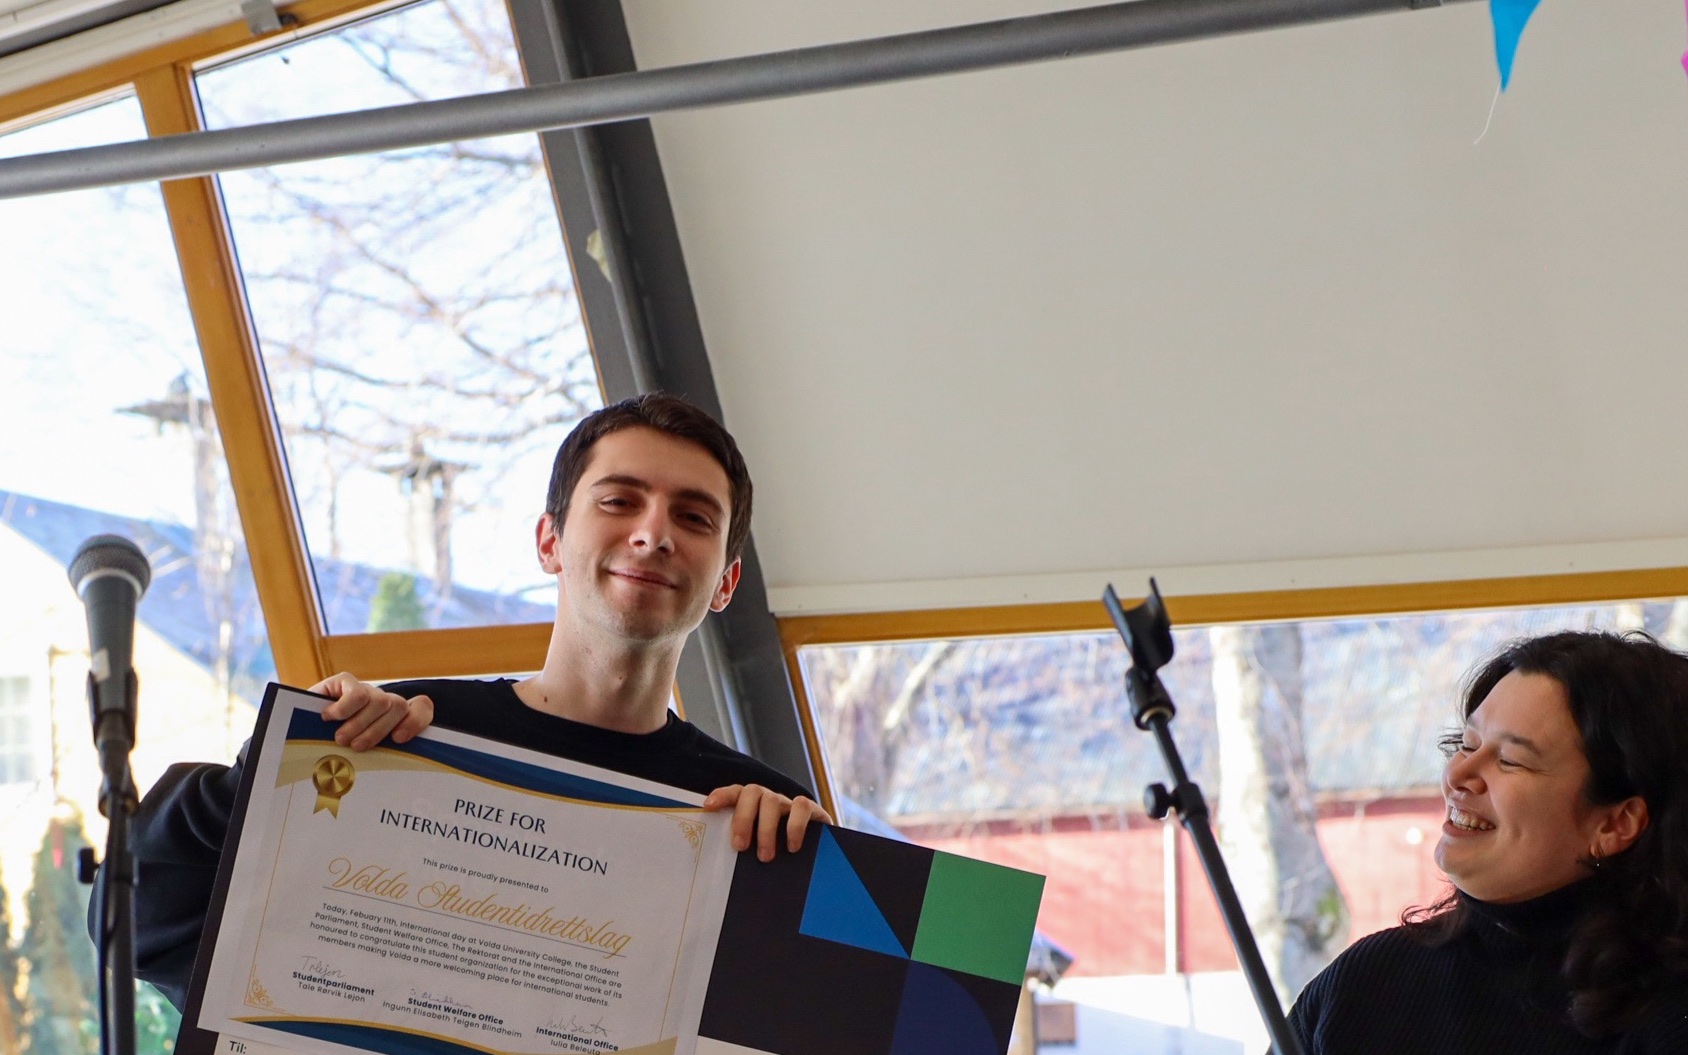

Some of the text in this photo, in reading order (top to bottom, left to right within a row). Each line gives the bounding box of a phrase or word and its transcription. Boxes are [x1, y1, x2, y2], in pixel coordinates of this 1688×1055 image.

[453, 798, 546, 835] PRIZE FOR
[379, 808, 608, 876] INTERNATIONALIZATION
[422, 857, 549, 894] This prize is proudly presented to
[328, 857, 632, 959] Volda Studentidrettslag
[314, 911, 623, 989] Parliament, Student Welfare Office, The Rektorat and the International Office are
[322, 902, 620, 978] Today, Febuary 11th, International day at Volda University College, the Student
[309, 921, 623, 1000] honoured to congratulate this student organization for the exceptional work of its
[317, 935, 611, 1008] members making Volda a more welcoming place for international students.
[292, 971, 375, 997] Studentparliament
[298, 981, 366, 1003] Tale Rørvik Lejon
[382, 1000, 523, 1039] Ingunn Elisabeth Teigen Blindheim
[407, 997, 442, 1012] Student
[443, 1005, 477, 1020] Welfare
[477, 1013, 504, 1026] Office
[229, 1040, 247, 1055] Til:
[535, 1026, 593, 1046] International
[593, 1039, 619, 1052] Office
